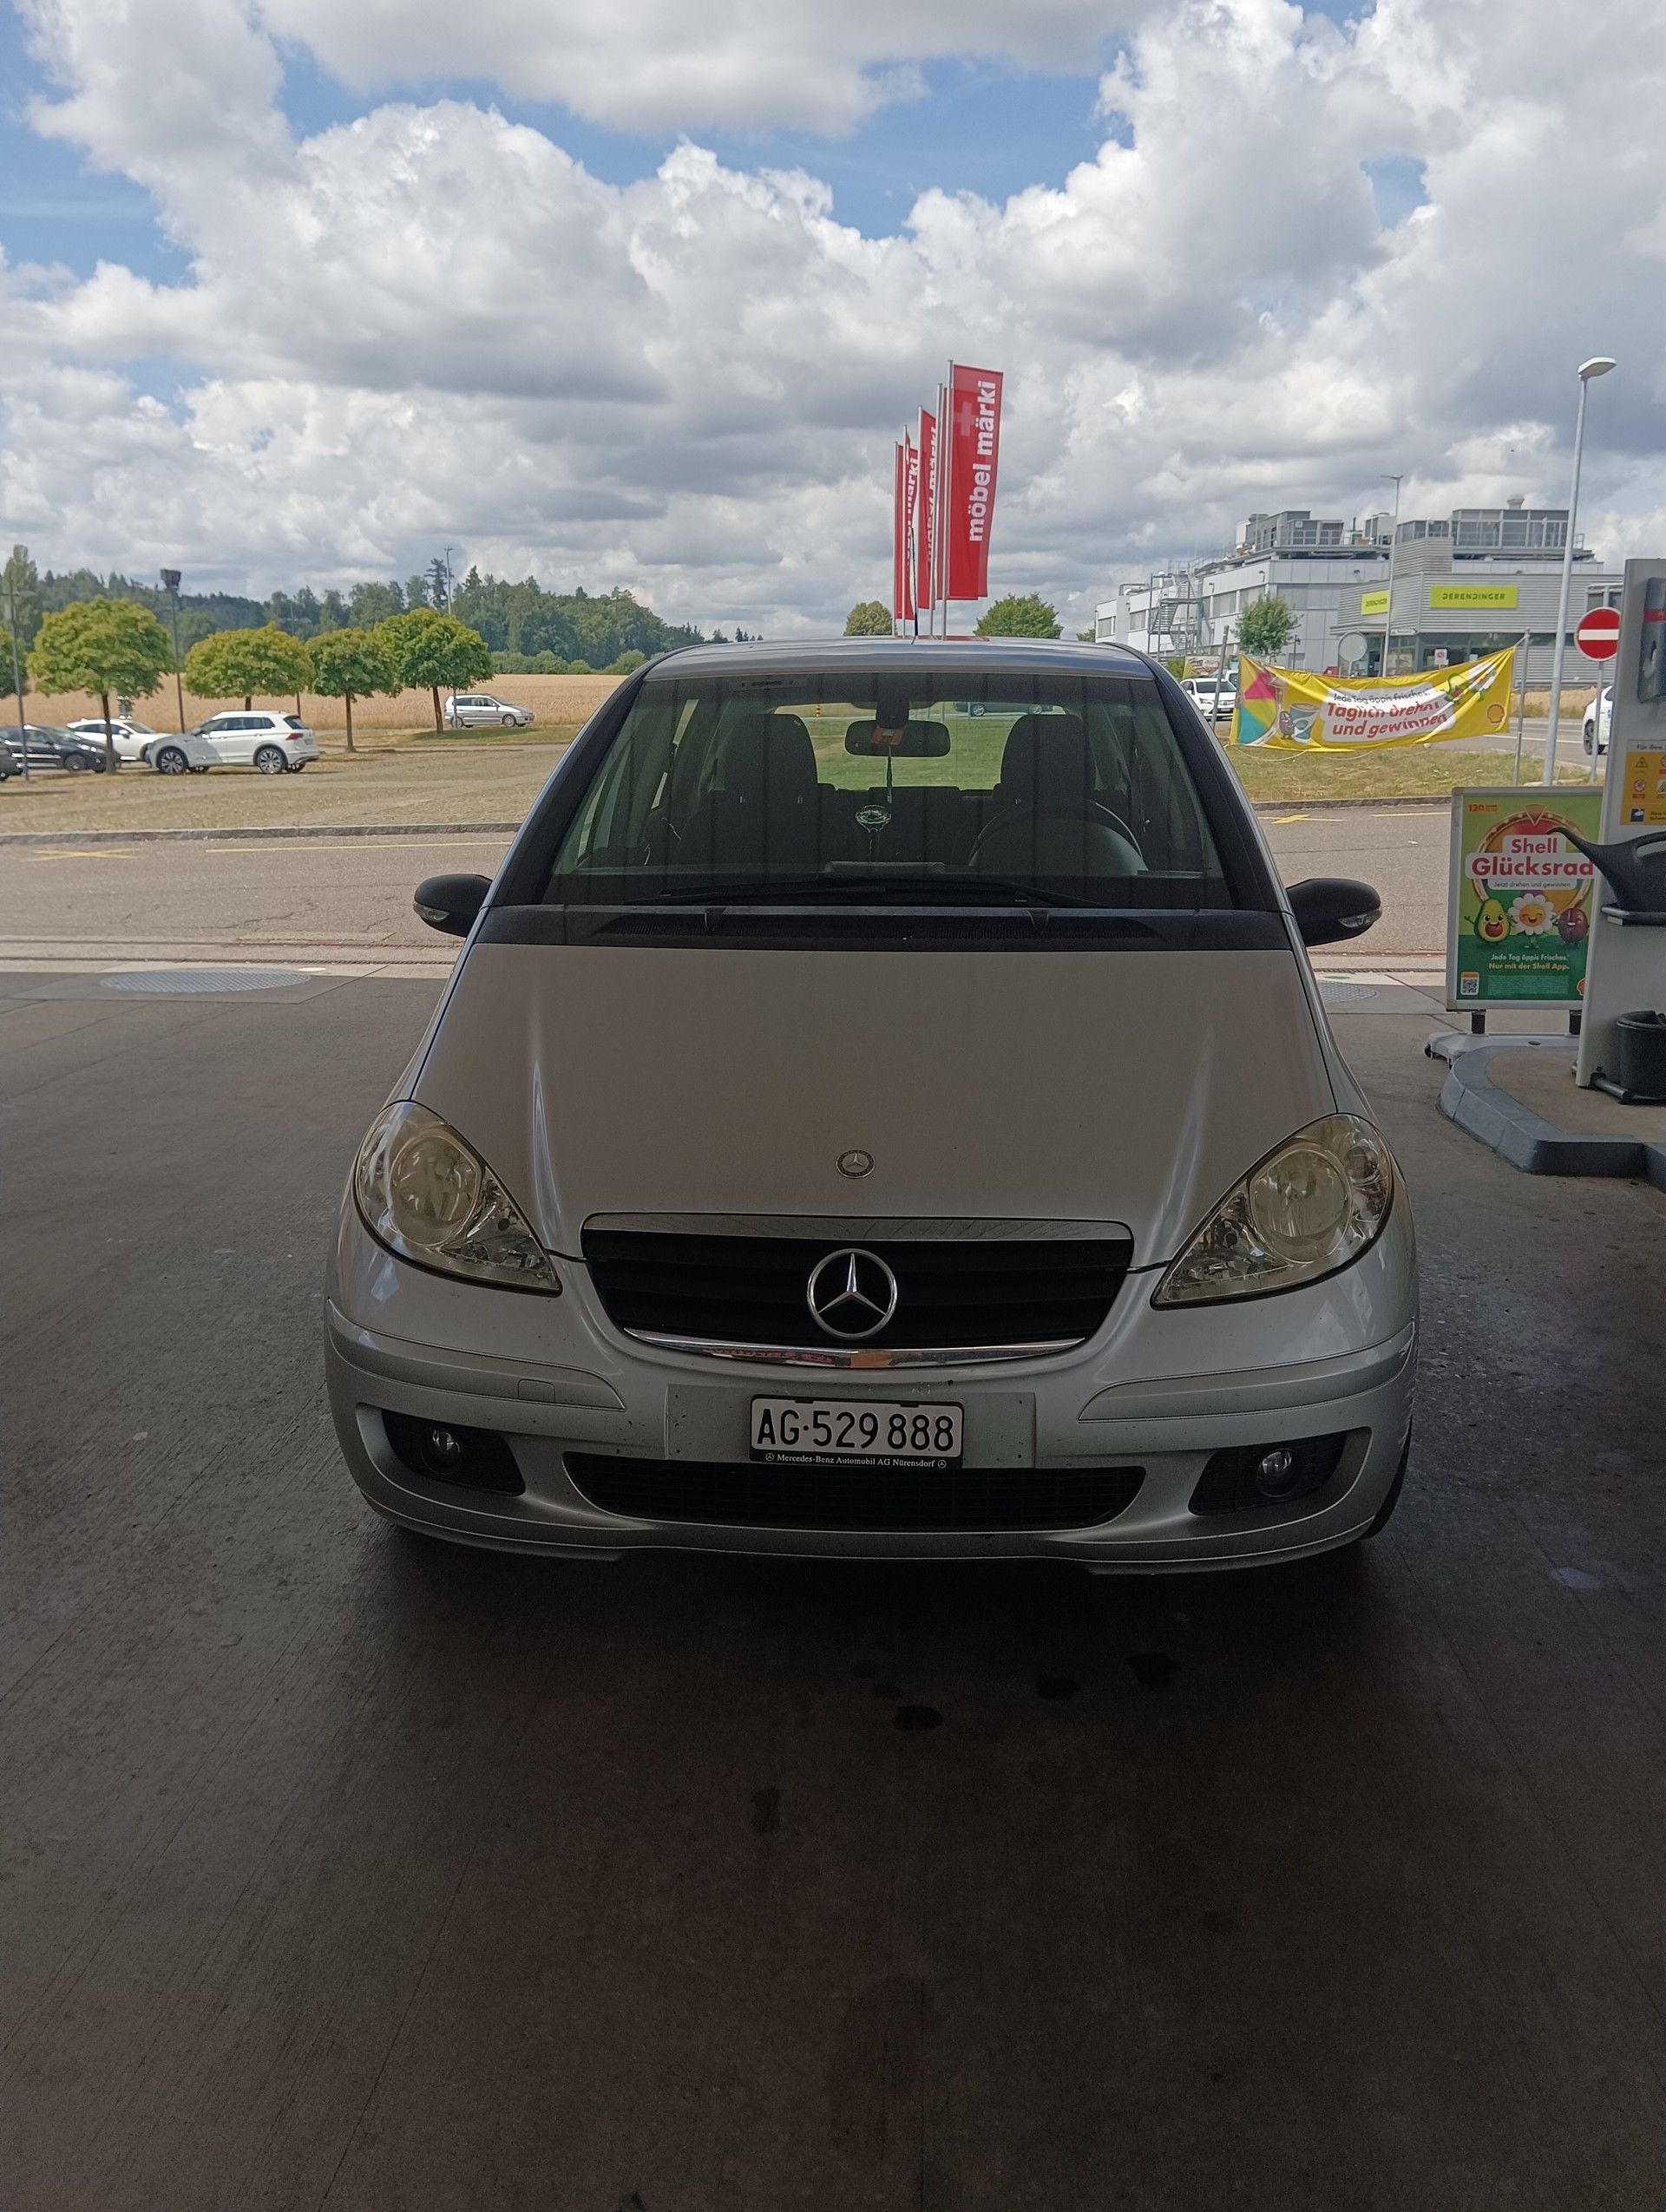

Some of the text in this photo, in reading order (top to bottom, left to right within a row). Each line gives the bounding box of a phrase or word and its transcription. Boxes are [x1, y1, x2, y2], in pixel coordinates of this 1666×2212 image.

[968, 381, 996, 542] möbel märki
[1328, 702, 1386, 722] Täglich
[1332, 713, 1448, 738] und gewinnen
[1468, 804, 1485, 813] 120
[1511, 838, 1558, 854] Shell
[1472, 856, 1593, 876] Glücksrad
[1543, 881, 1571, 890] gewinnen
[777, 1454, 835, 1464] Mercedes-Benz
[836, 1456, 876, 1466] Automobil
[893, 1458, 935, 1468] Nürensdorf
